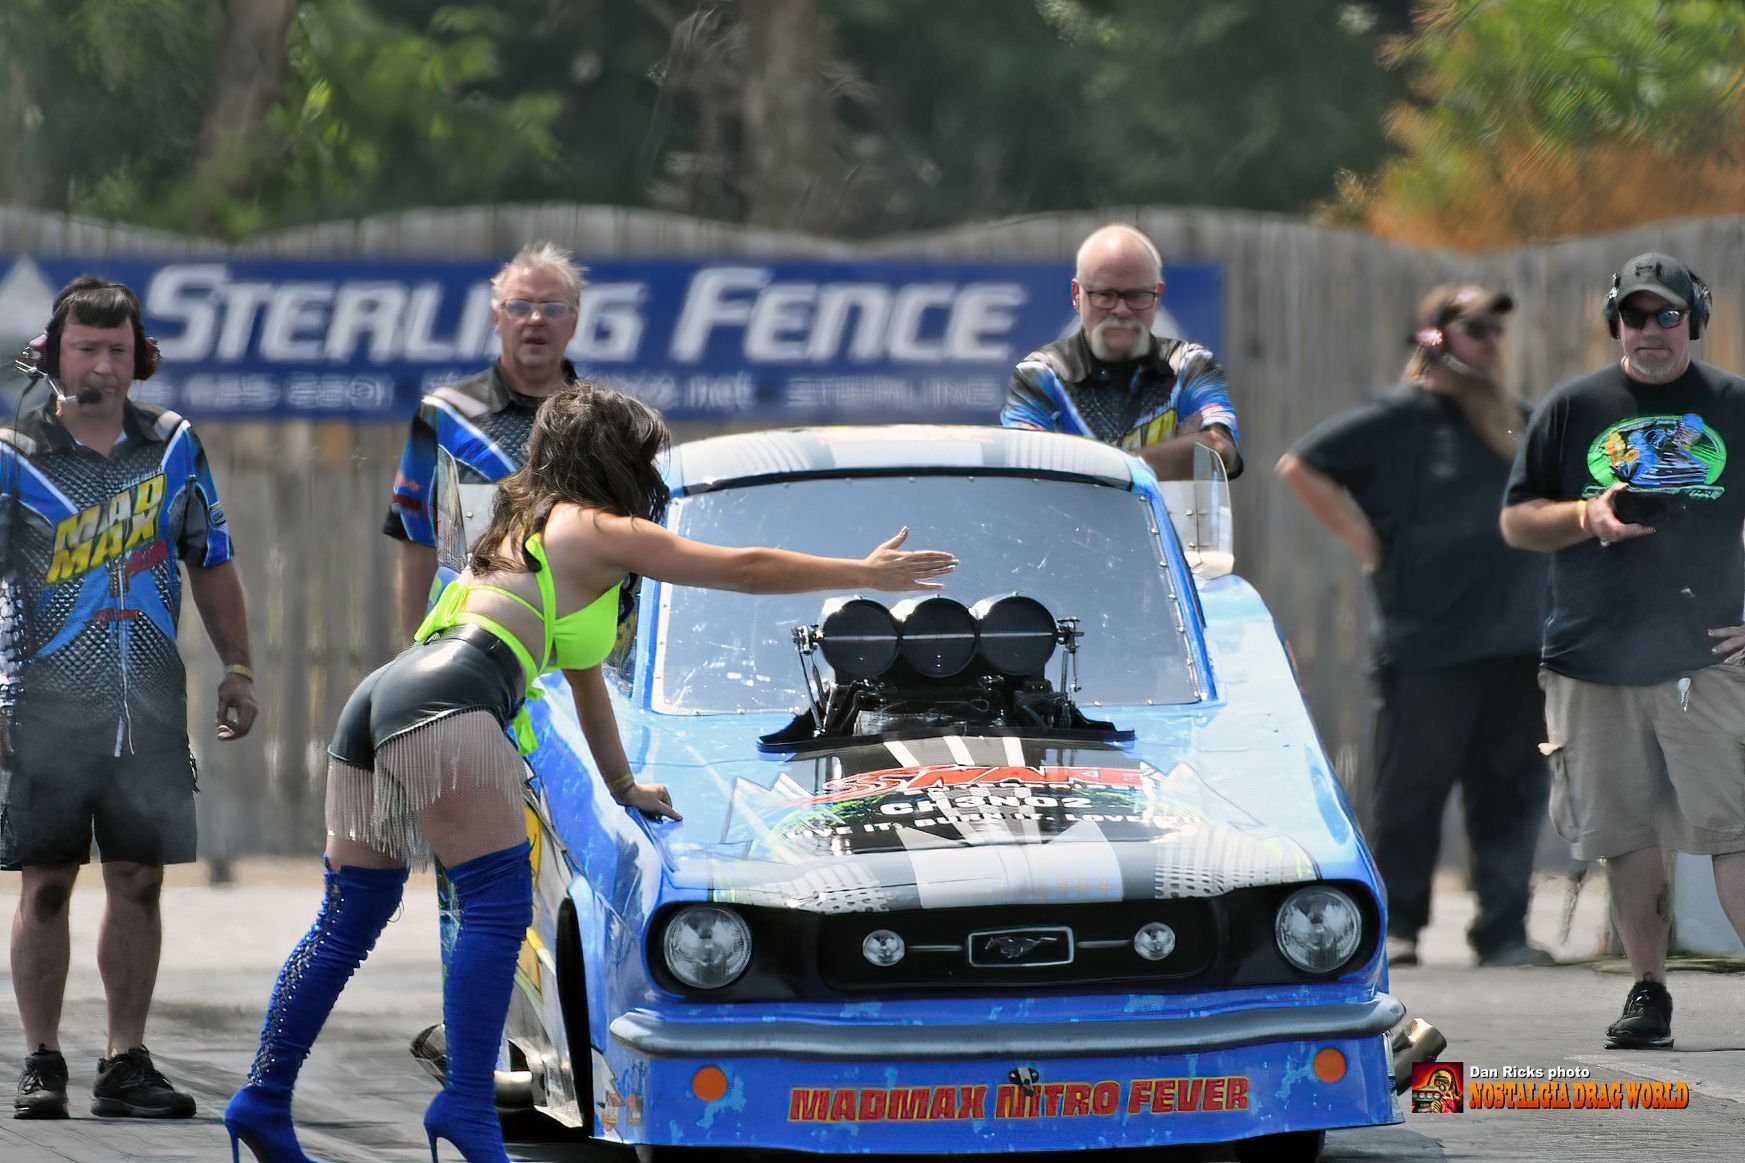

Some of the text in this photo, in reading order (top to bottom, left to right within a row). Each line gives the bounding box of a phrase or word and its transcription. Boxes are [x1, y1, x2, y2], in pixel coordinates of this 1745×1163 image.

[145, 264, 1027, 364] STERLIG FENCE
[46, 509, 161, 584] MAX
[54, 474, 166, 550] MAD
[787, 1076, 1250, 1122] MADMAX NITRO FEVER
